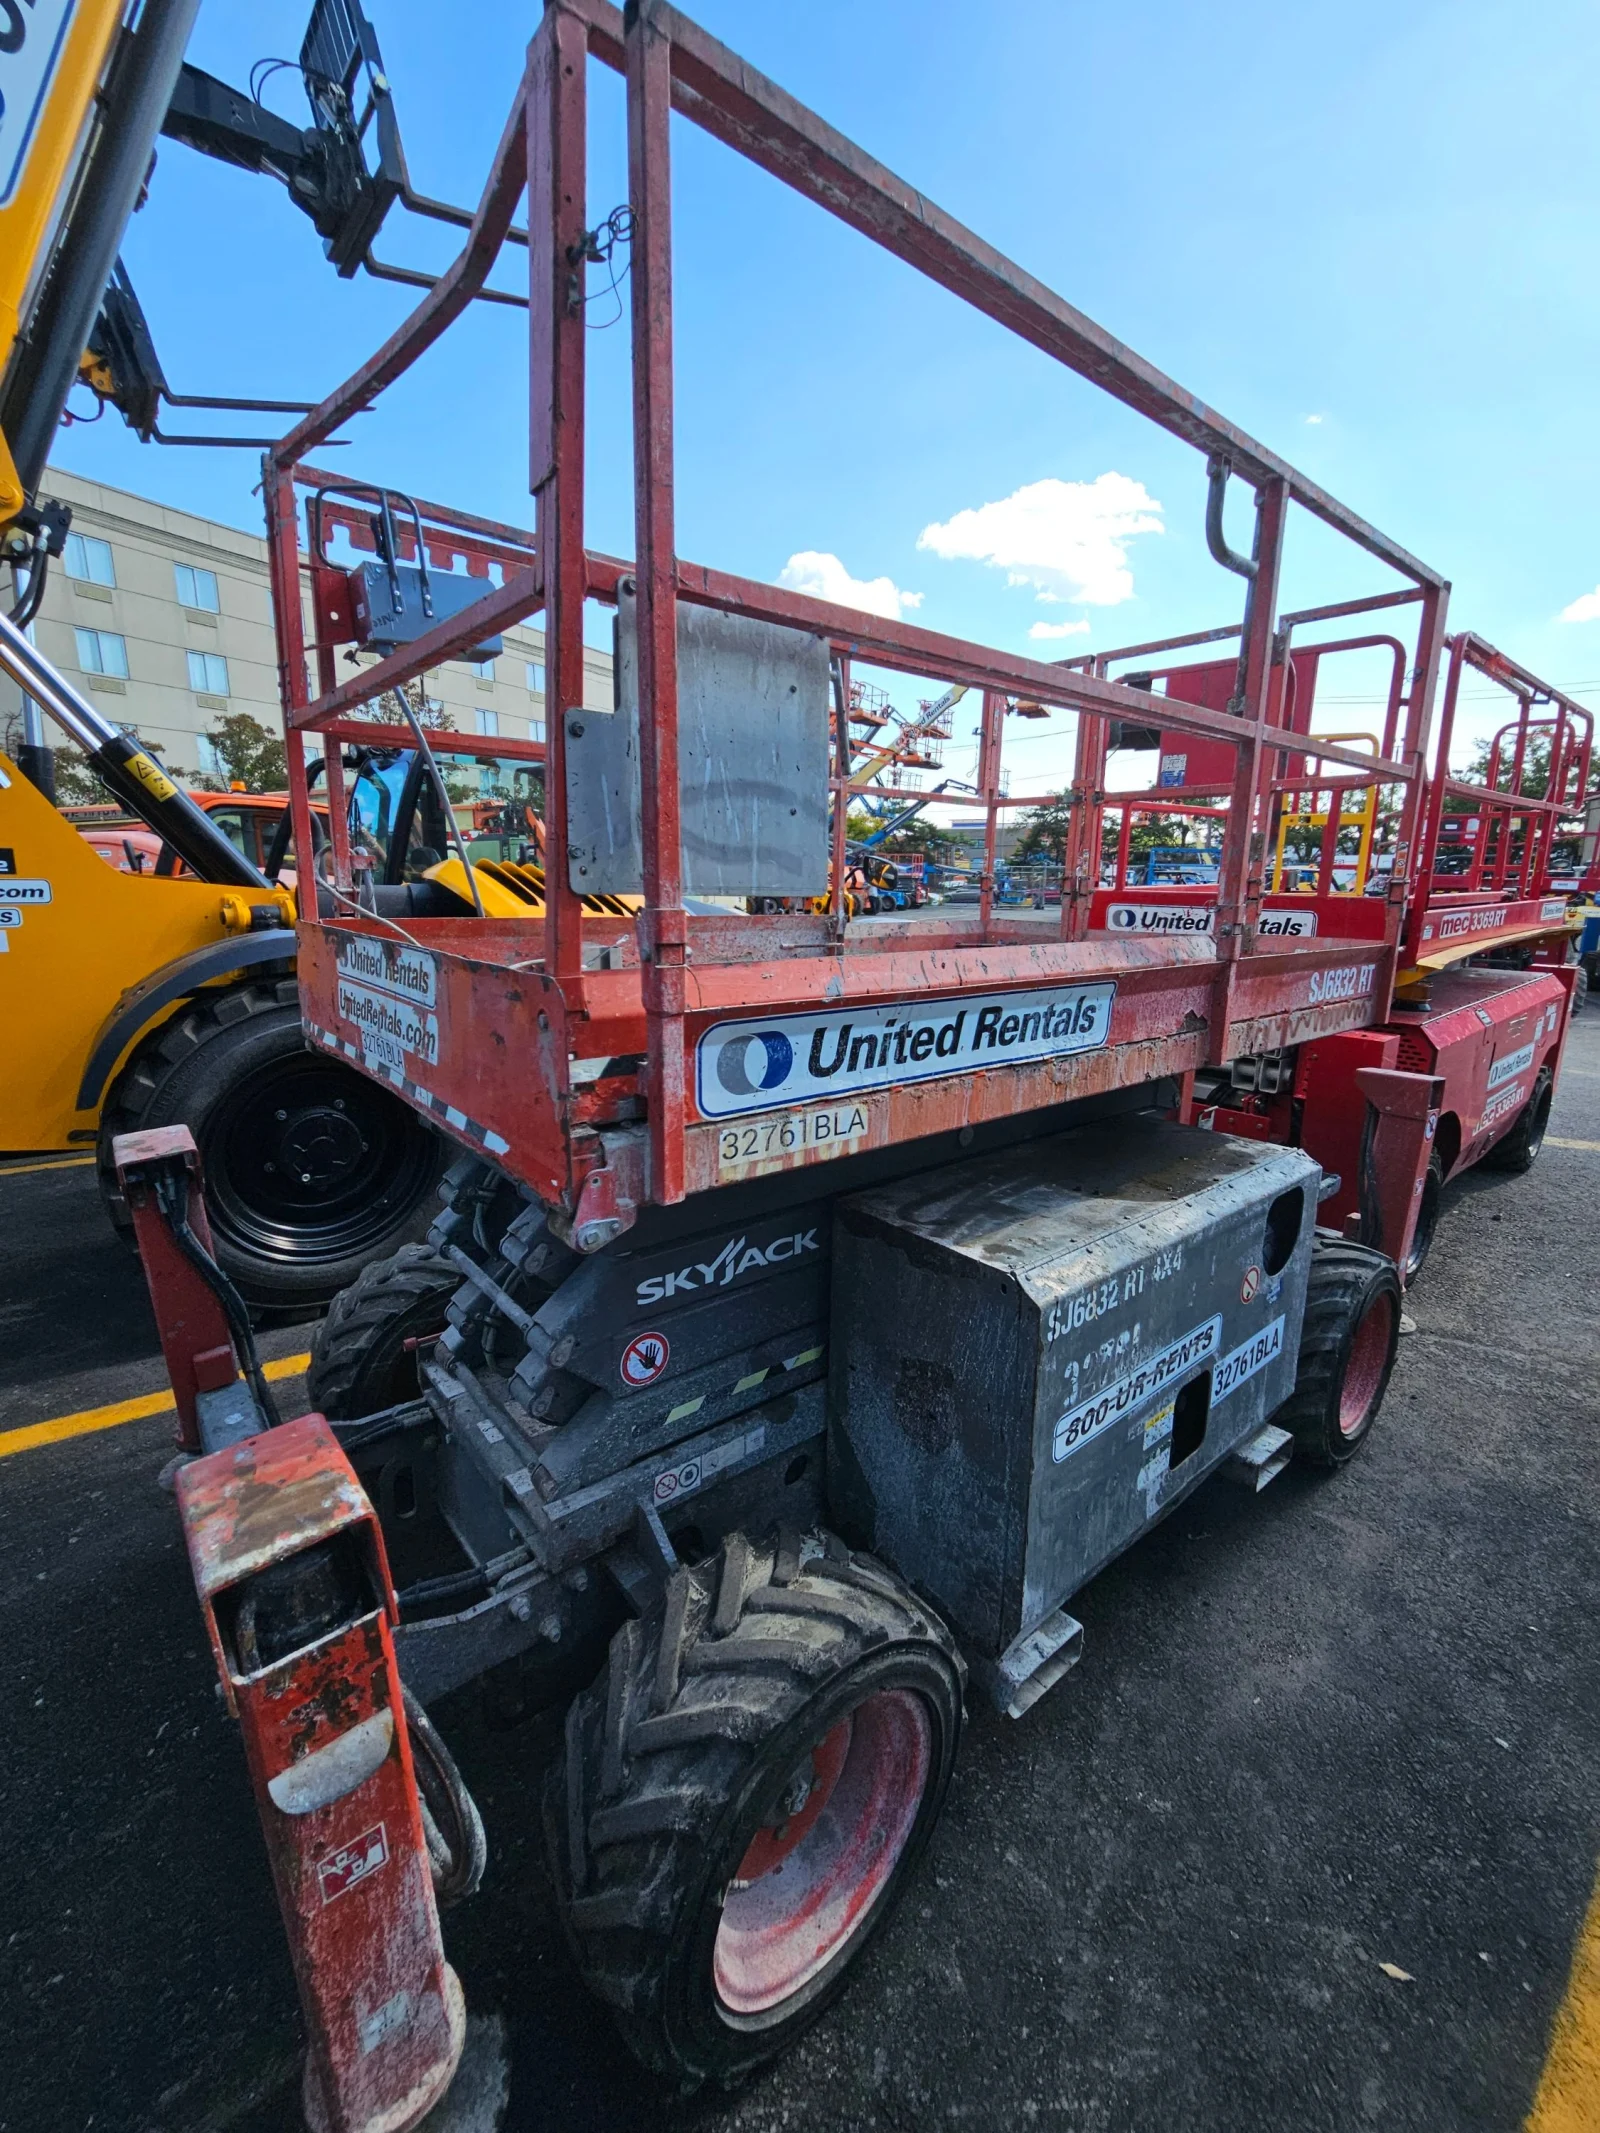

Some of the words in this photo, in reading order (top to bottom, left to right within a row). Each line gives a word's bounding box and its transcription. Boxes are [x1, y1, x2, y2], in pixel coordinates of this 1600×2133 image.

[926, 696, 950, 719] Rentals
[1141, 911, 1211, 931] United
[1258, 917, 1302, 936] tals
[1440, 914, 1470, 936] mec
[350, 944, 382, 977] United
[385, 958, 429, 994] Rentals
[1309, 967, 1357, 1003] SJ6832
[1359, 964, 1376, 992] RT
[339, 988, 436, 1054] UnitedRentals.com
[808, 1010, 968, 1077] United
[971, 996, 1096, 1050] Rentals
[362, 1031, 404, 1069] 32761BLA
[722, 1107, 865, 1159] 32761BLA
[636, 1228, 819, 1305] SKYJACK
[1047, 1279, 1118, 1342] SJ6832
[1065, 1324, 1214, 1447] 800-UR-RENTS
[1215, 1327, 1279, 1397] 32761BLA
